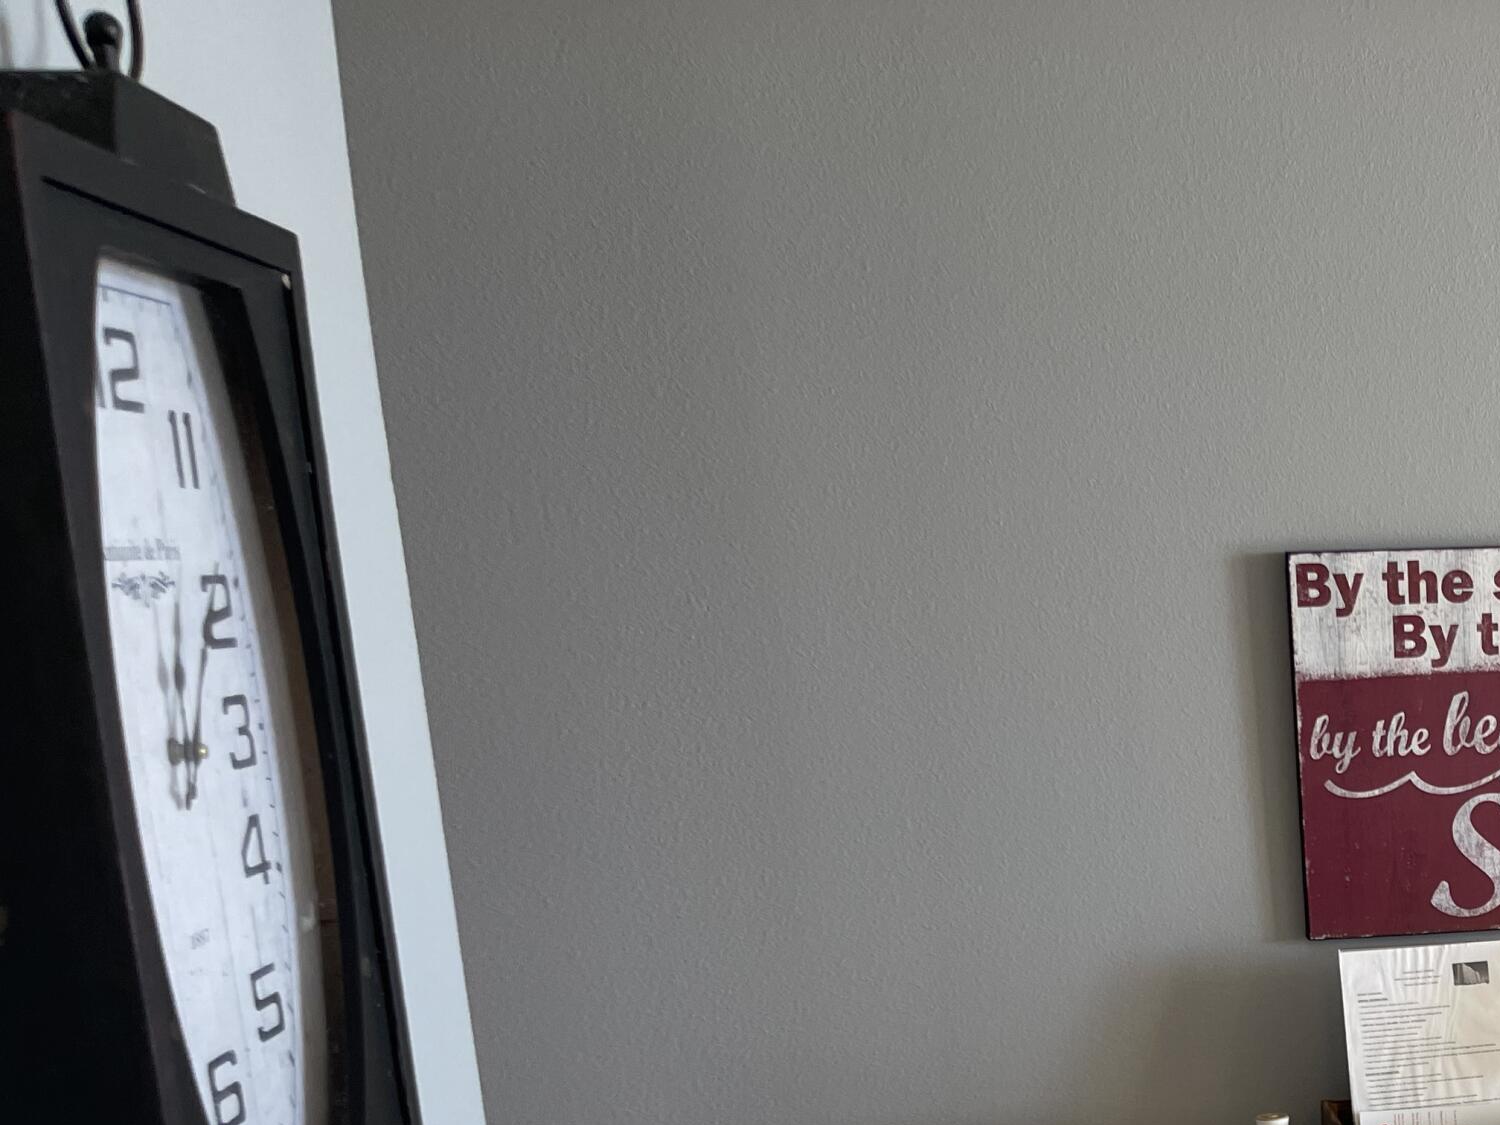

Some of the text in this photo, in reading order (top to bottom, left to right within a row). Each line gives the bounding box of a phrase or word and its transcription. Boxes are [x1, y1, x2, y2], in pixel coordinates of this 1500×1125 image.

[200, 574, 239, 650] 2
[1296, 562, 1364, 617] By
[1382, 560, 1474, 605] the
[1392, 614, 1458, 668] By
[221, 694, 257, 770] 3
[1309, 714, 1360, 774] by
[1371, 711, 1431, 758] the
[240, 813, 271, 885] 4
[249, 962, 286, 1042] 5
